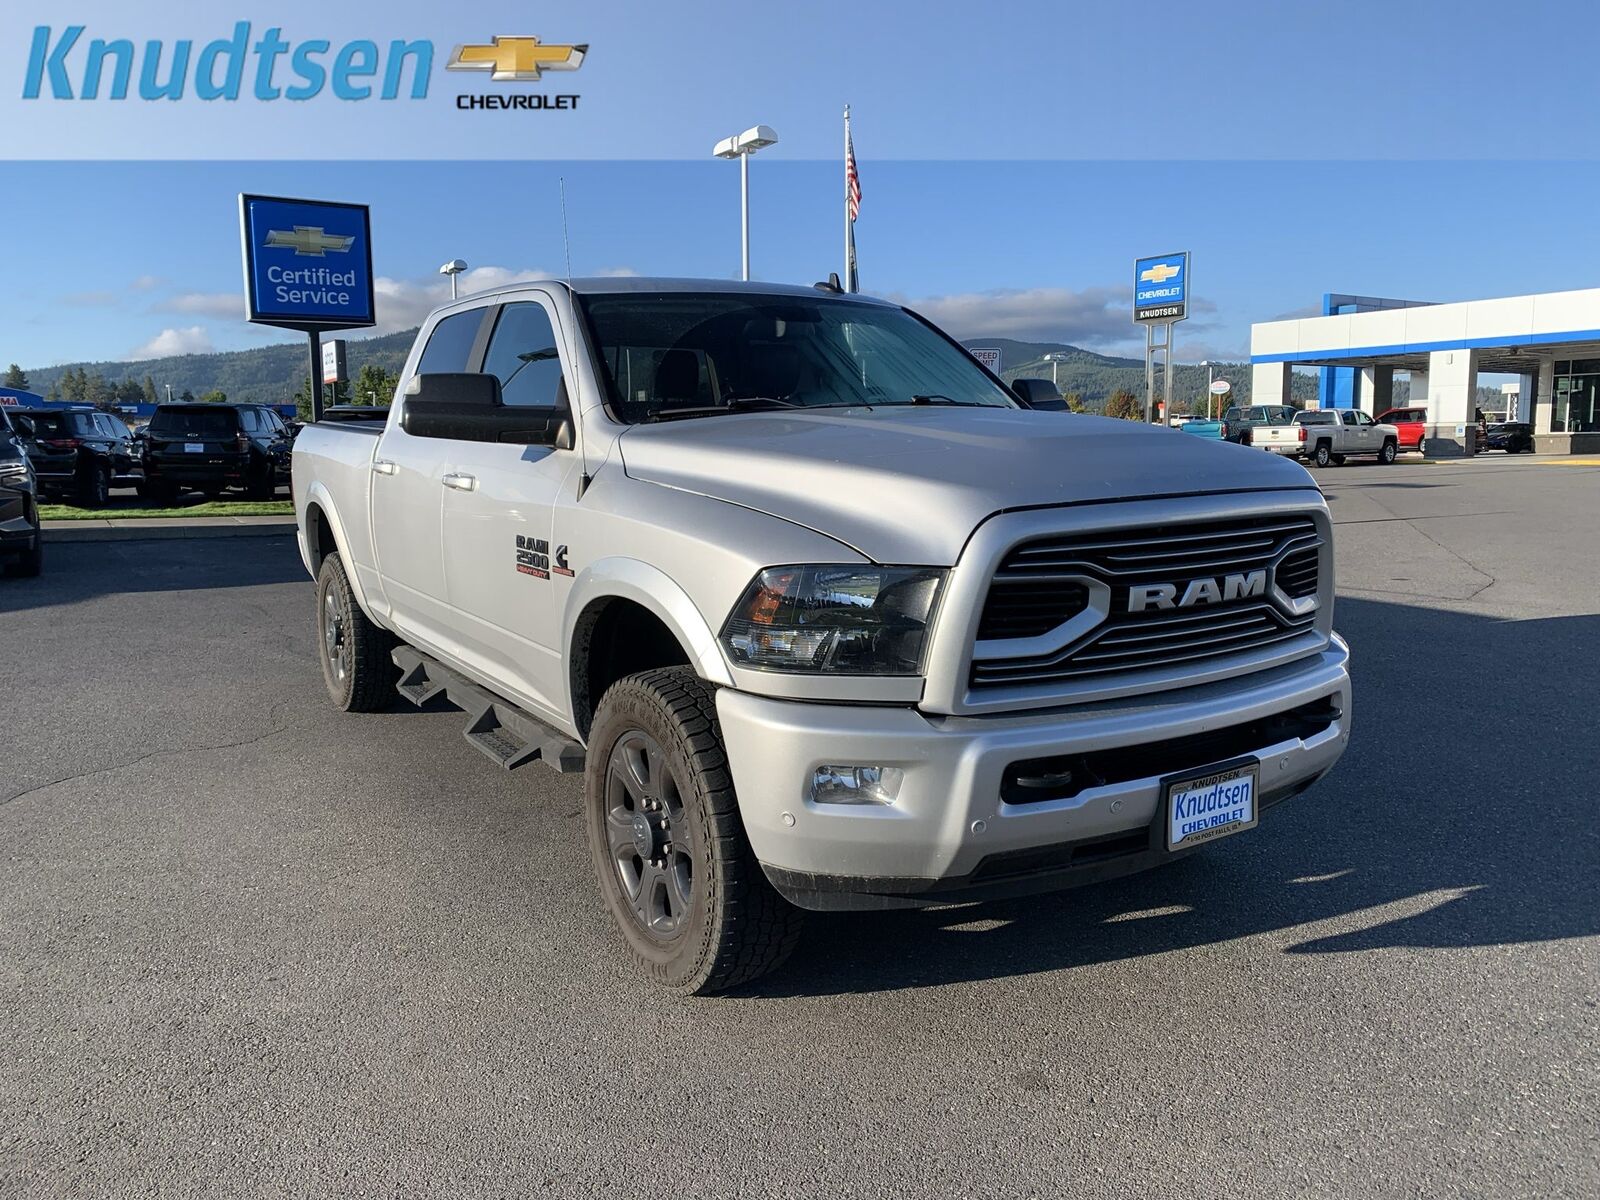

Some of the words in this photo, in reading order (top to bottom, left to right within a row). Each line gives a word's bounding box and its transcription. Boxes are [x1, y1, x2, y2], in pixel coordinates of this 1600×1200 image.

[267, 266, 355, 286] Certified
[276, 286, 350, 305] Service
[1138, 287, 1180, 299] CHEVROLET
[1140, 307, 1178, 318] KNUDTSEN
[974, 352, 998, 360] SPEED
[516, 534, 549, 555] RAM
[516, 549, 549, 570] 2500
[1128, 569, 1266, 612] RAM
[1191, 770, 1240, 789] KNUDTSEN
[1175, 782, 1249, 820] Knudtsen
[1181, 807, 1244, 835] CHEVROLET
[1201, 831, 1214, 839] POST
